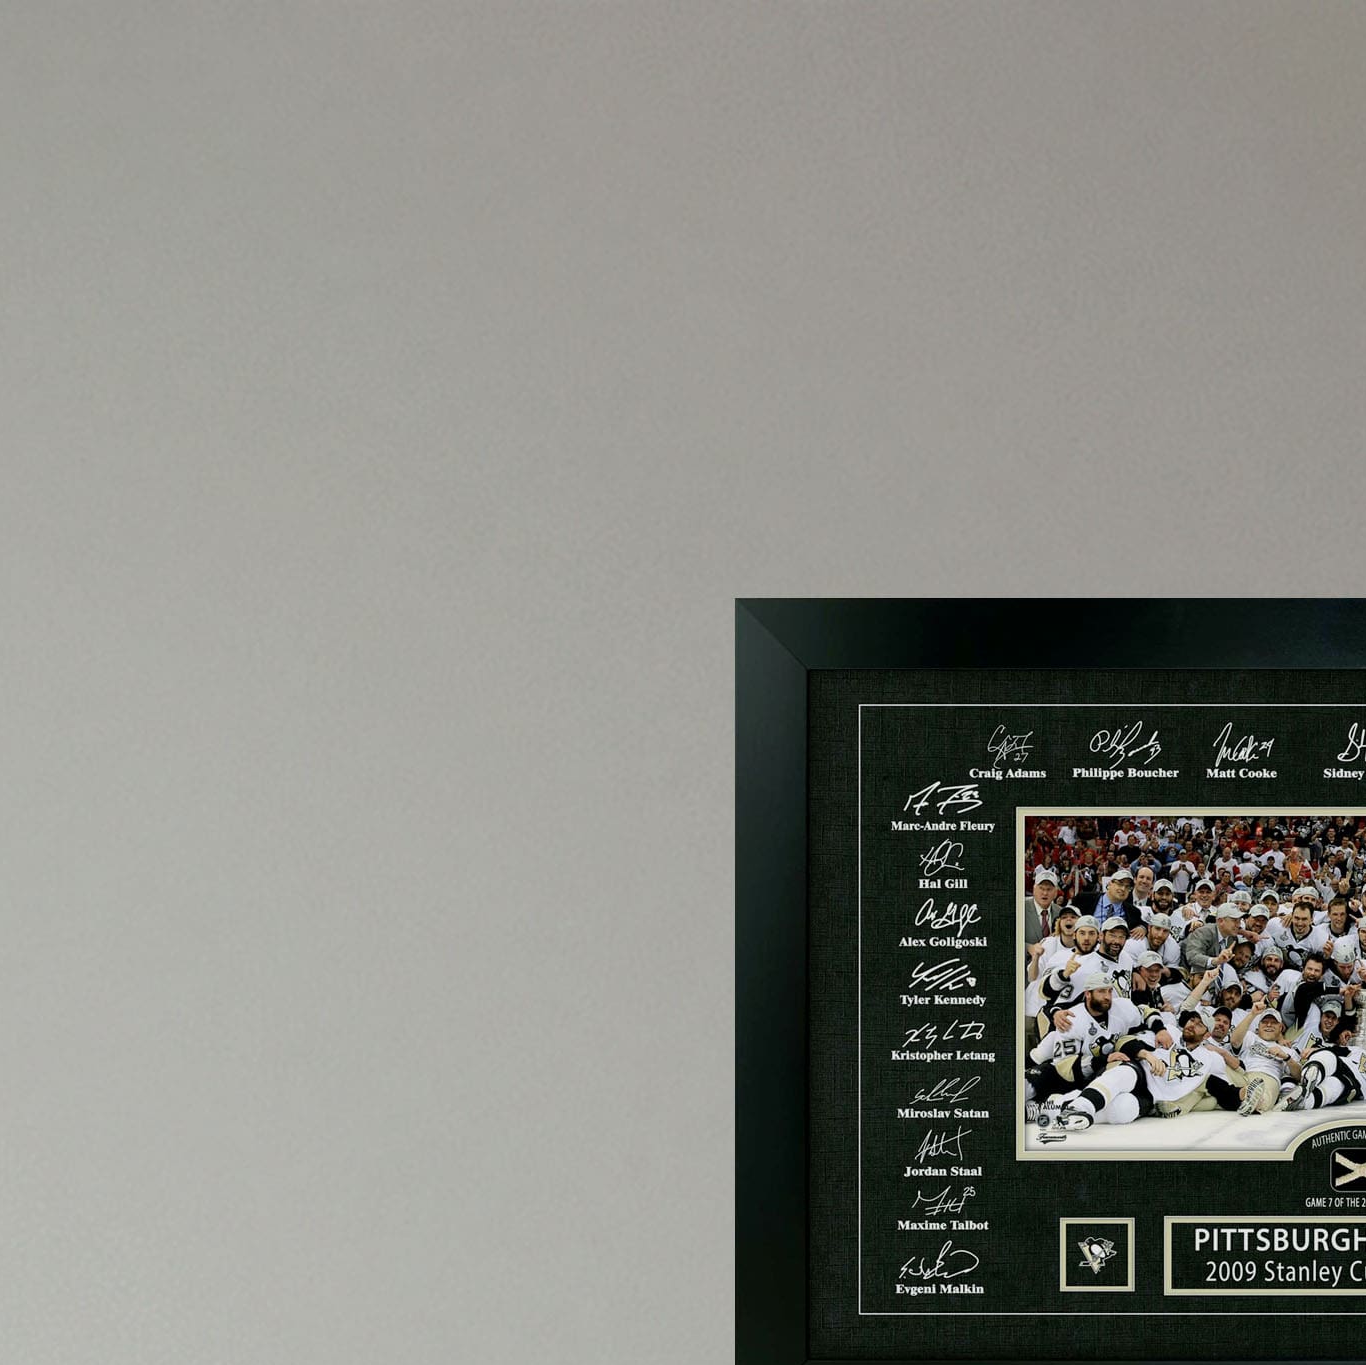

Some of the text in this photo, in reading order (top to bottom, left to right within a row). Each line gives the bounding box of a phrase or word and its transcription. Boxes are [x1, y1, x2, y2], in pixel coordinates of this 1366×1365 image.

[968, 767, 1047, 782] Craig Adams
[1072, 767, 1180, 782] Philippe Boucher
[1206, 768, 1278, 779] Matt Cooke
[1323, 767, 1365, 781] Sidney
[891, 820, 996, 833] Marc-Andre Fleury
[918, 878, 968, 889] Hal Gill
[898, 936, 988, 950] Alex Goligoski
[899, 994, 987, 1007] Tyler Kennedy
[891, 1050, 996, 1063] Kristopher Letang
[897, 1108, 990, 1119] Miroslav Satan
[1311, 1129, 1351, 1149] AUTHENTIC
[903, 1166, 983, 1178] Jordan Staal
[1305, 1197, 1327, 1208] GAME
[1328, 1197, 1333, 1208] 7
[1334, 1197, 1345, 1208] OF
[1345, 1197, 1360, 1208] THE
[897, 1219, 989, 1231] Maxime Talbot
[1205, 1260, 1257, 1282] 2009
[1264, 1259, 1343, 1288] Stanley
[895, 1283, 985, 1297] Evgeni Malkin
